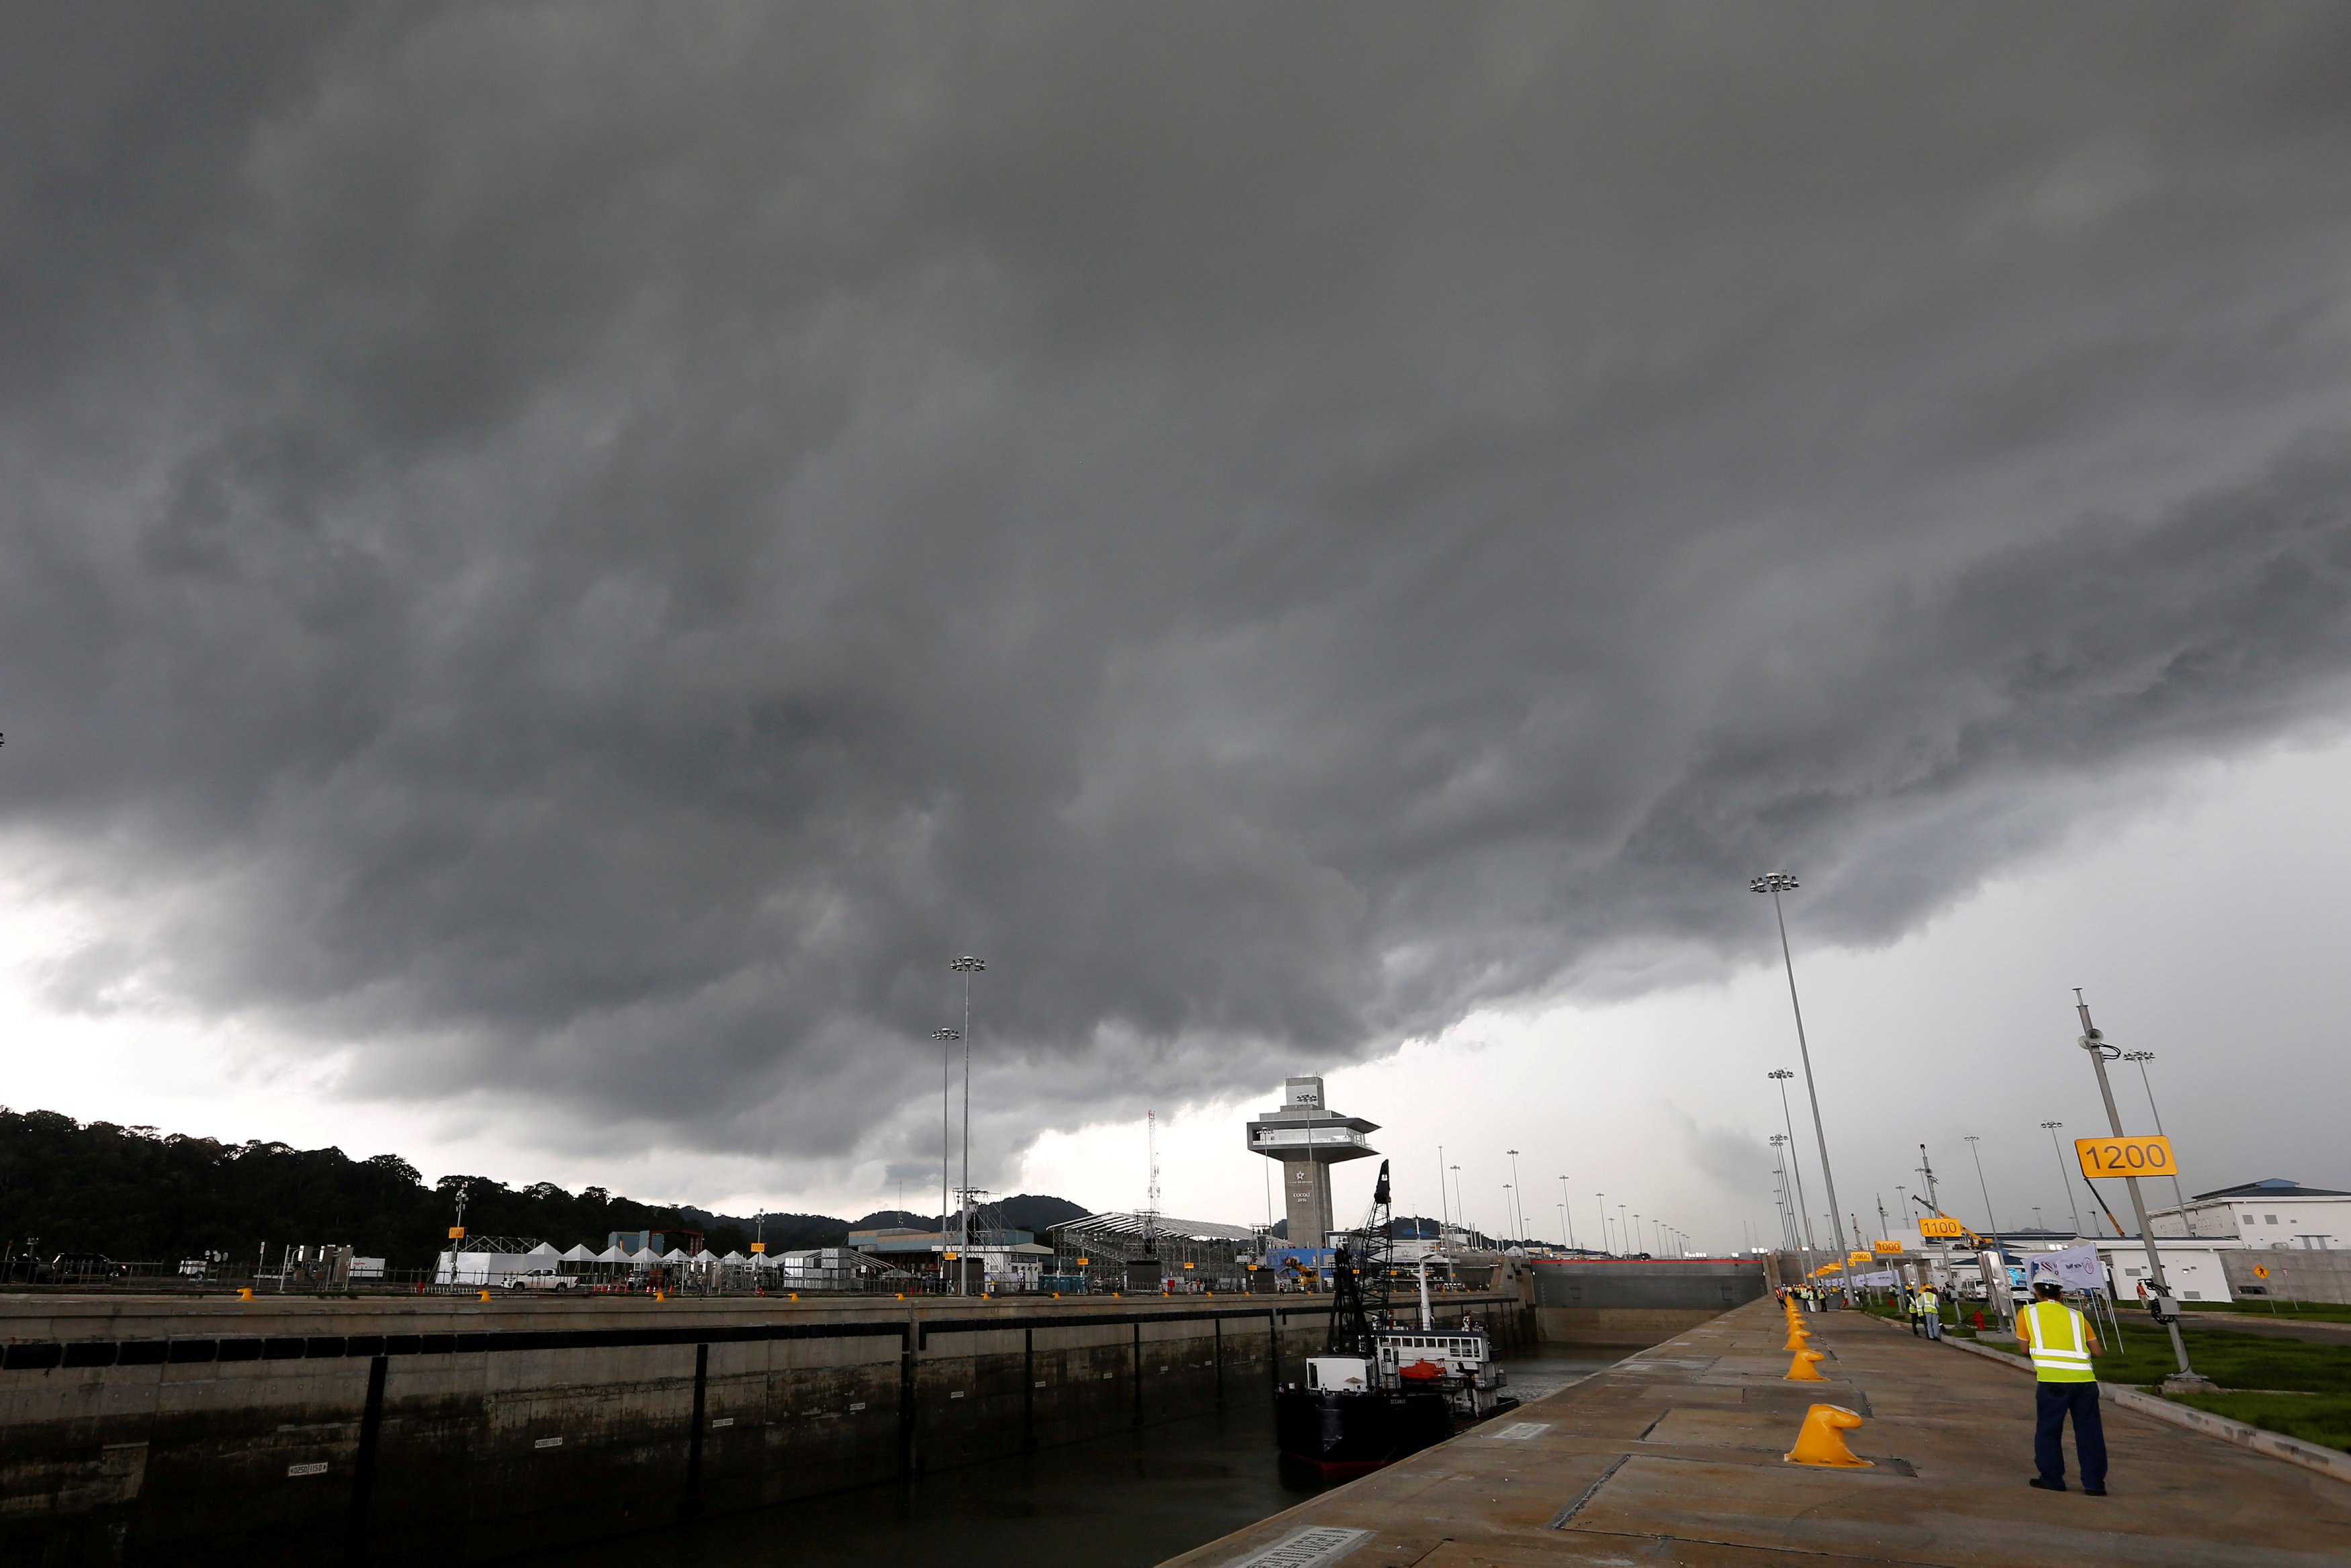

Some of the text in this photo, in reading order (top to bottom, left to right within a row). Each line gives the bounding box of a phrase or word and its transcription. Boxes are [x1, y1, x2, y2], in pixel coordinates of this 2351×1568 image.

[2086, 1144, 2166, 1170] 1200
[1924, 1222, 1957, 1234] 1100
[1877, 1242, 1900, 1251] 1000
[294, 1464, 322, 1474] 0250 1150
